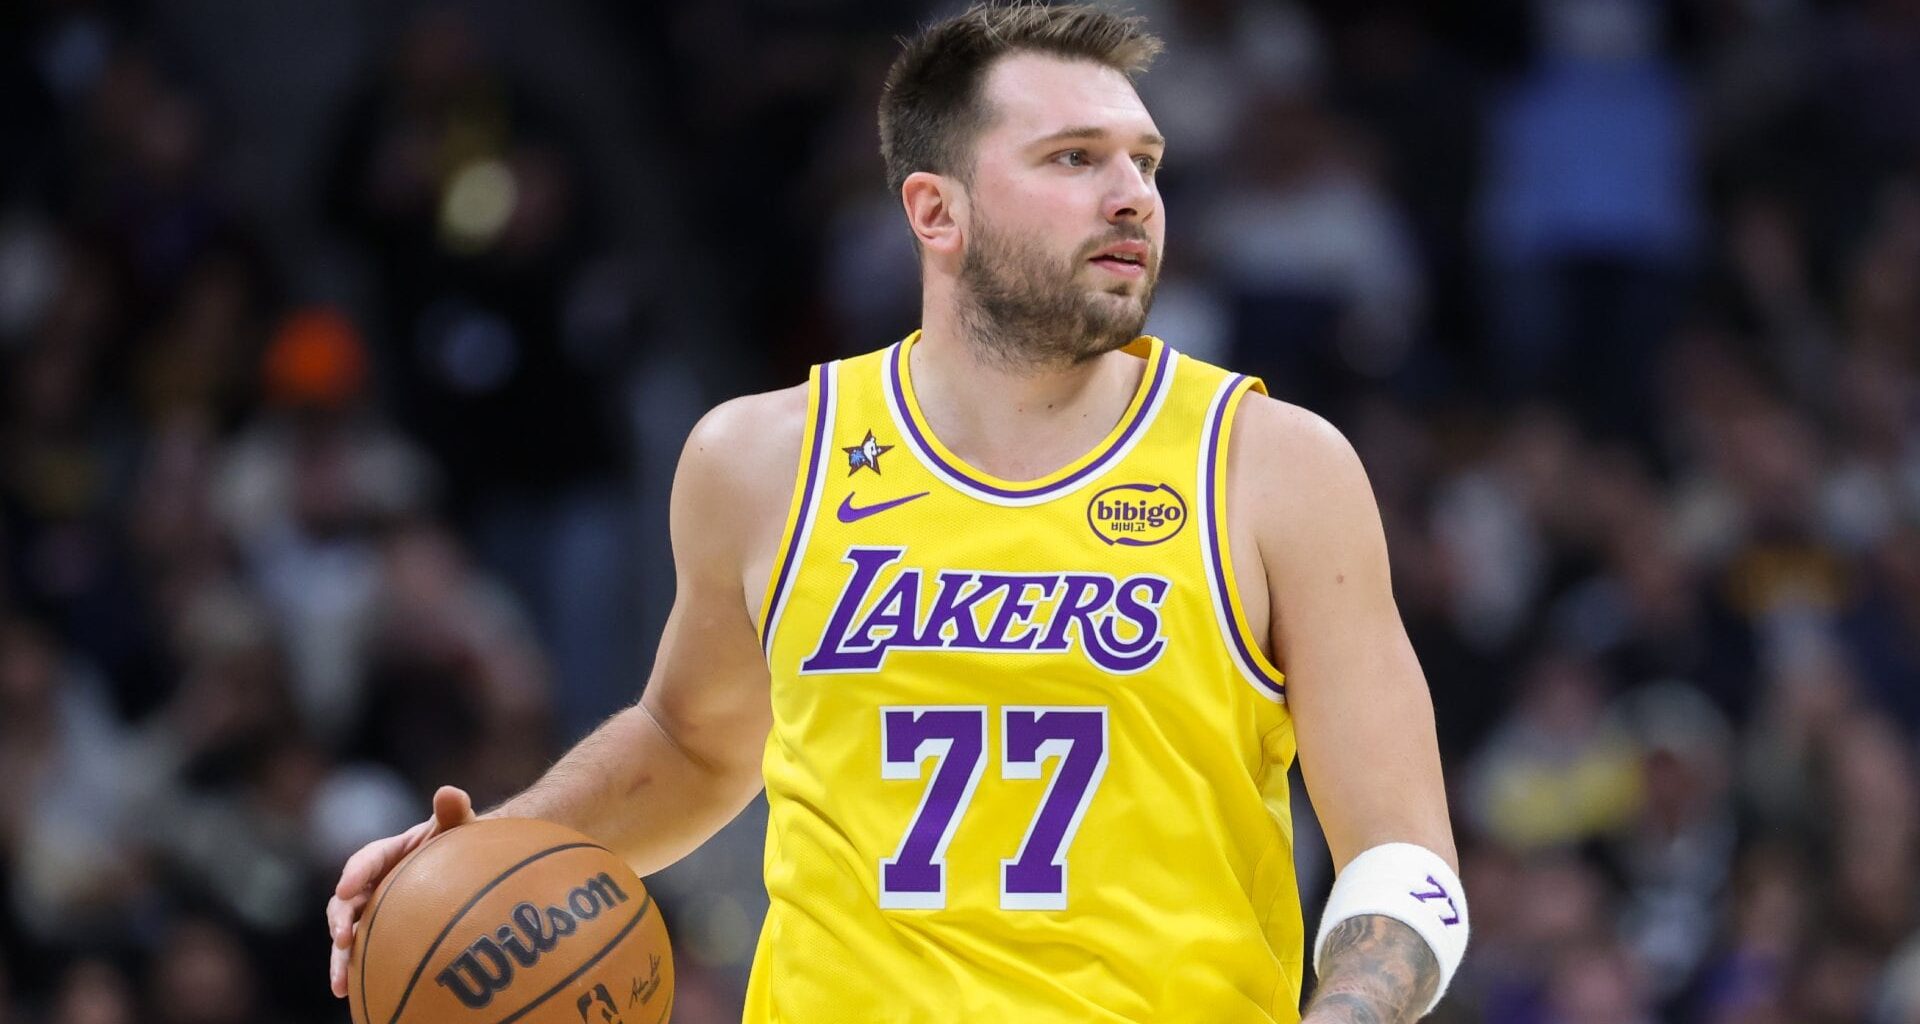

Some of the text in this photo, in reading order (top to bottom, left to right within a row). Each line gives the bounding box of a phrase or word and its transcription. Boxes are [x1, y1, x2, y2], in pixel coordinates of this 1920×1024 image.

[1097, 500, 1181, 527] bibigo
[1111, 522, 1145, 532] 비비고
[800, 545, 1173, 675] LAKERS
[879, 705, 1108, 910] 77
[434, 871, 629, 1009] Wilson
[1410, 875, 1459, 927] 77
